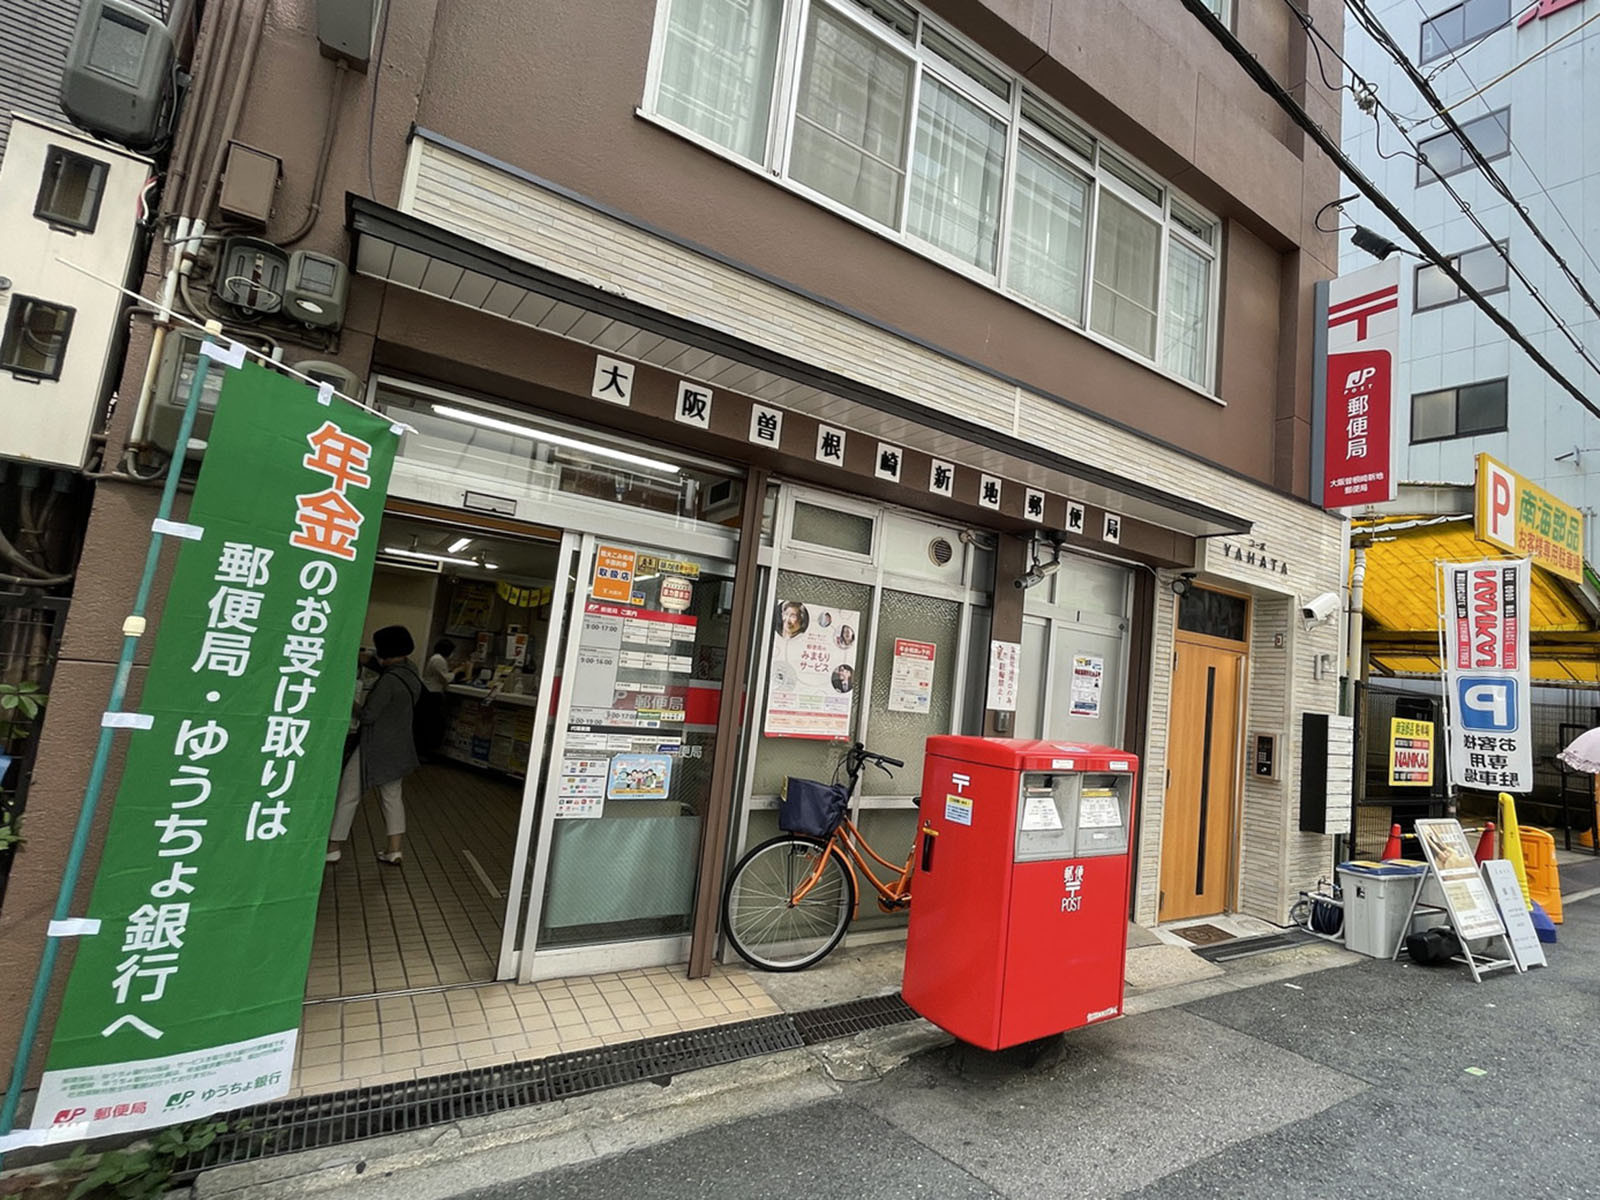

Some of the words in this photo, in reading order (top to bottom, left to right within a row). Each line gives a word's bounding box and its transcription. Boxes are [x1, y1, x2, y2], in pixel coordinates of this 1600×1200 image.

[1345, 393, 1369, 461] 郵便局
[600, 364, 1118, 540] 大阪曽根崎新地郵便局
[1344, 483, 1369, 495] 郵便局
[1492, 471, 1510, 535] P
[1223, 543, 1288, 575] YAHATA
[245, 419, 374, 842] 年金のお受け取りは
[800, 661, 830, 673] サービス
[801, 650, 831, 663] みまもり
[100, 540, 274, 1040] 郵便局・ゆうちょ銀行へ
[1061, 896, 1082, 912] POST
[200, 1070, 282, 1102] ゆうちょ銀行
[93, 1101, 148, 1122] 郵便局
